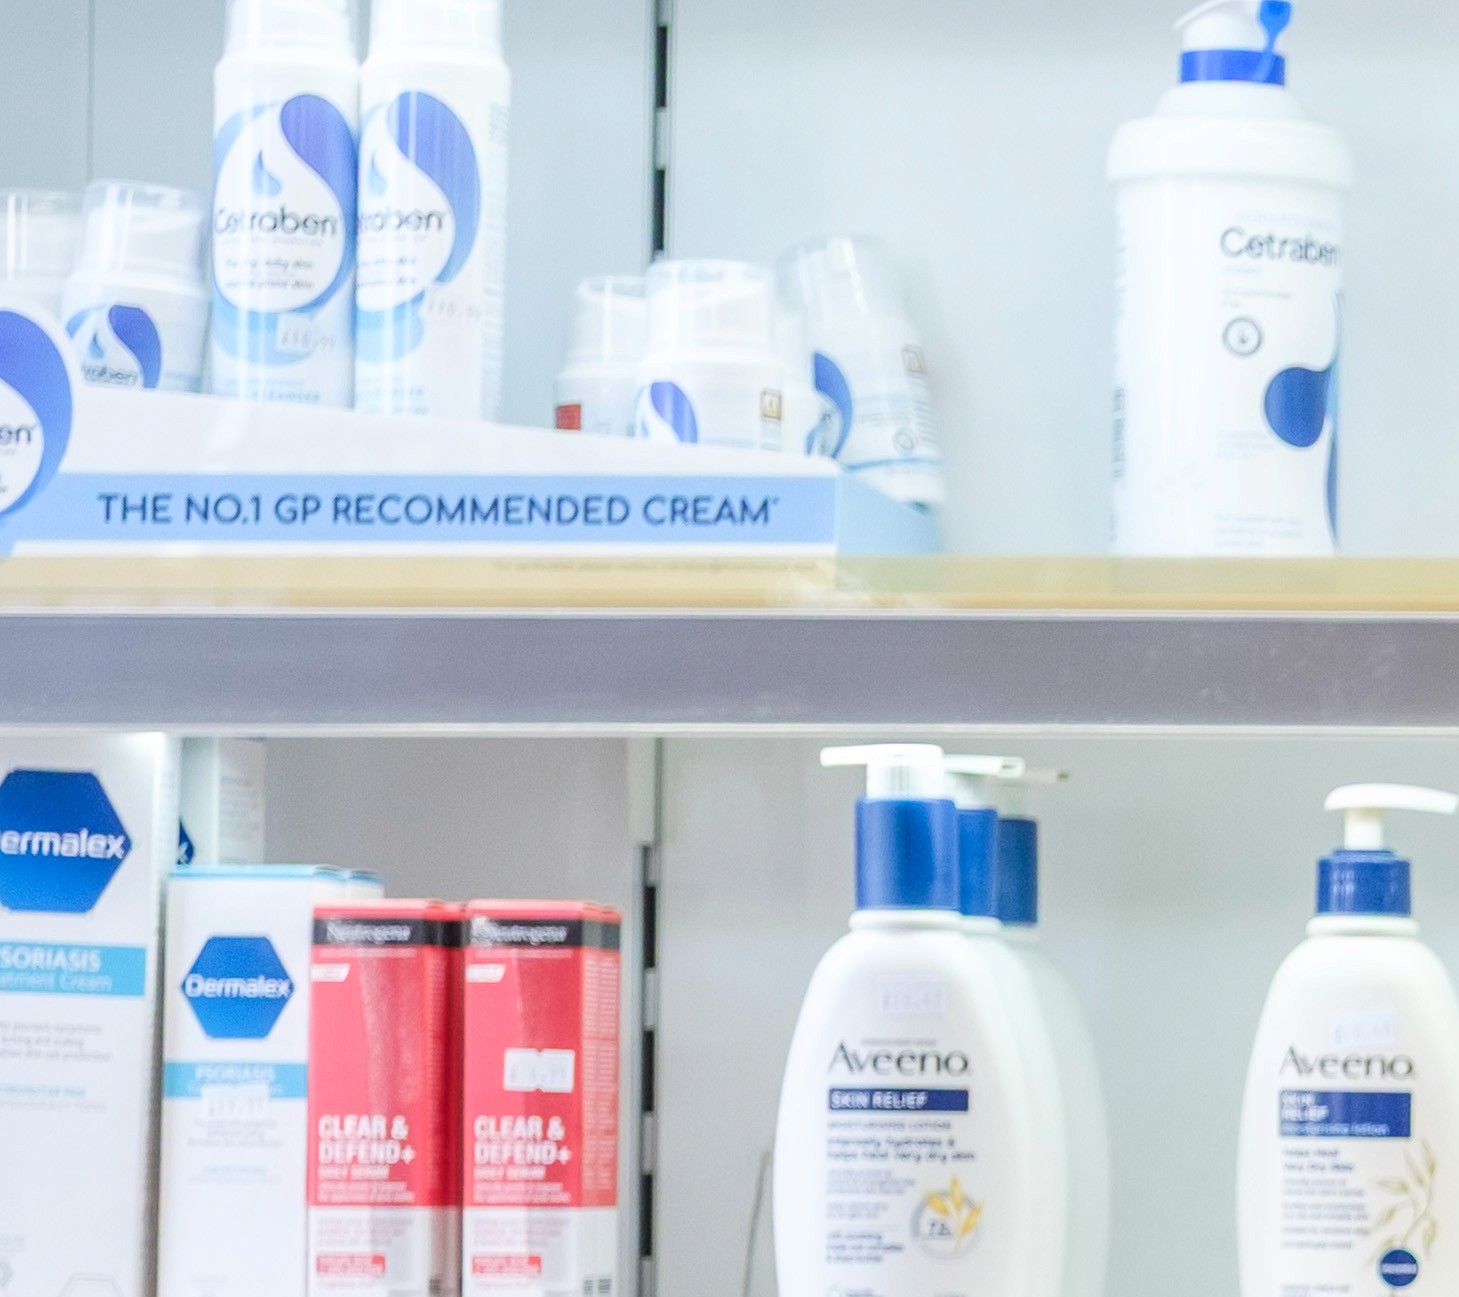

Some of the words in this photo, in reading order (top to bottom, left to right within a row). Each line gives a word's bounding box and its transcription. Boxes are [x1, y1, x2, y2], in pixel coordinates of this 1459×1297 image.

[97, 492, 174, 524] THE
[184, 492, 263, 526] NO.1
[274, 492, 323, 526] GP
[331, 492, 632, 527] RECOMMENDED
[641, 493, 774, 527] CREAM
[0, 828, 126, 860] ermalex
[184, 972, 291, 1000] Dermalex
[828, 1040, 971, 1076] Aveeno
[1278, 1046, 1414, 1081] Aveeno
